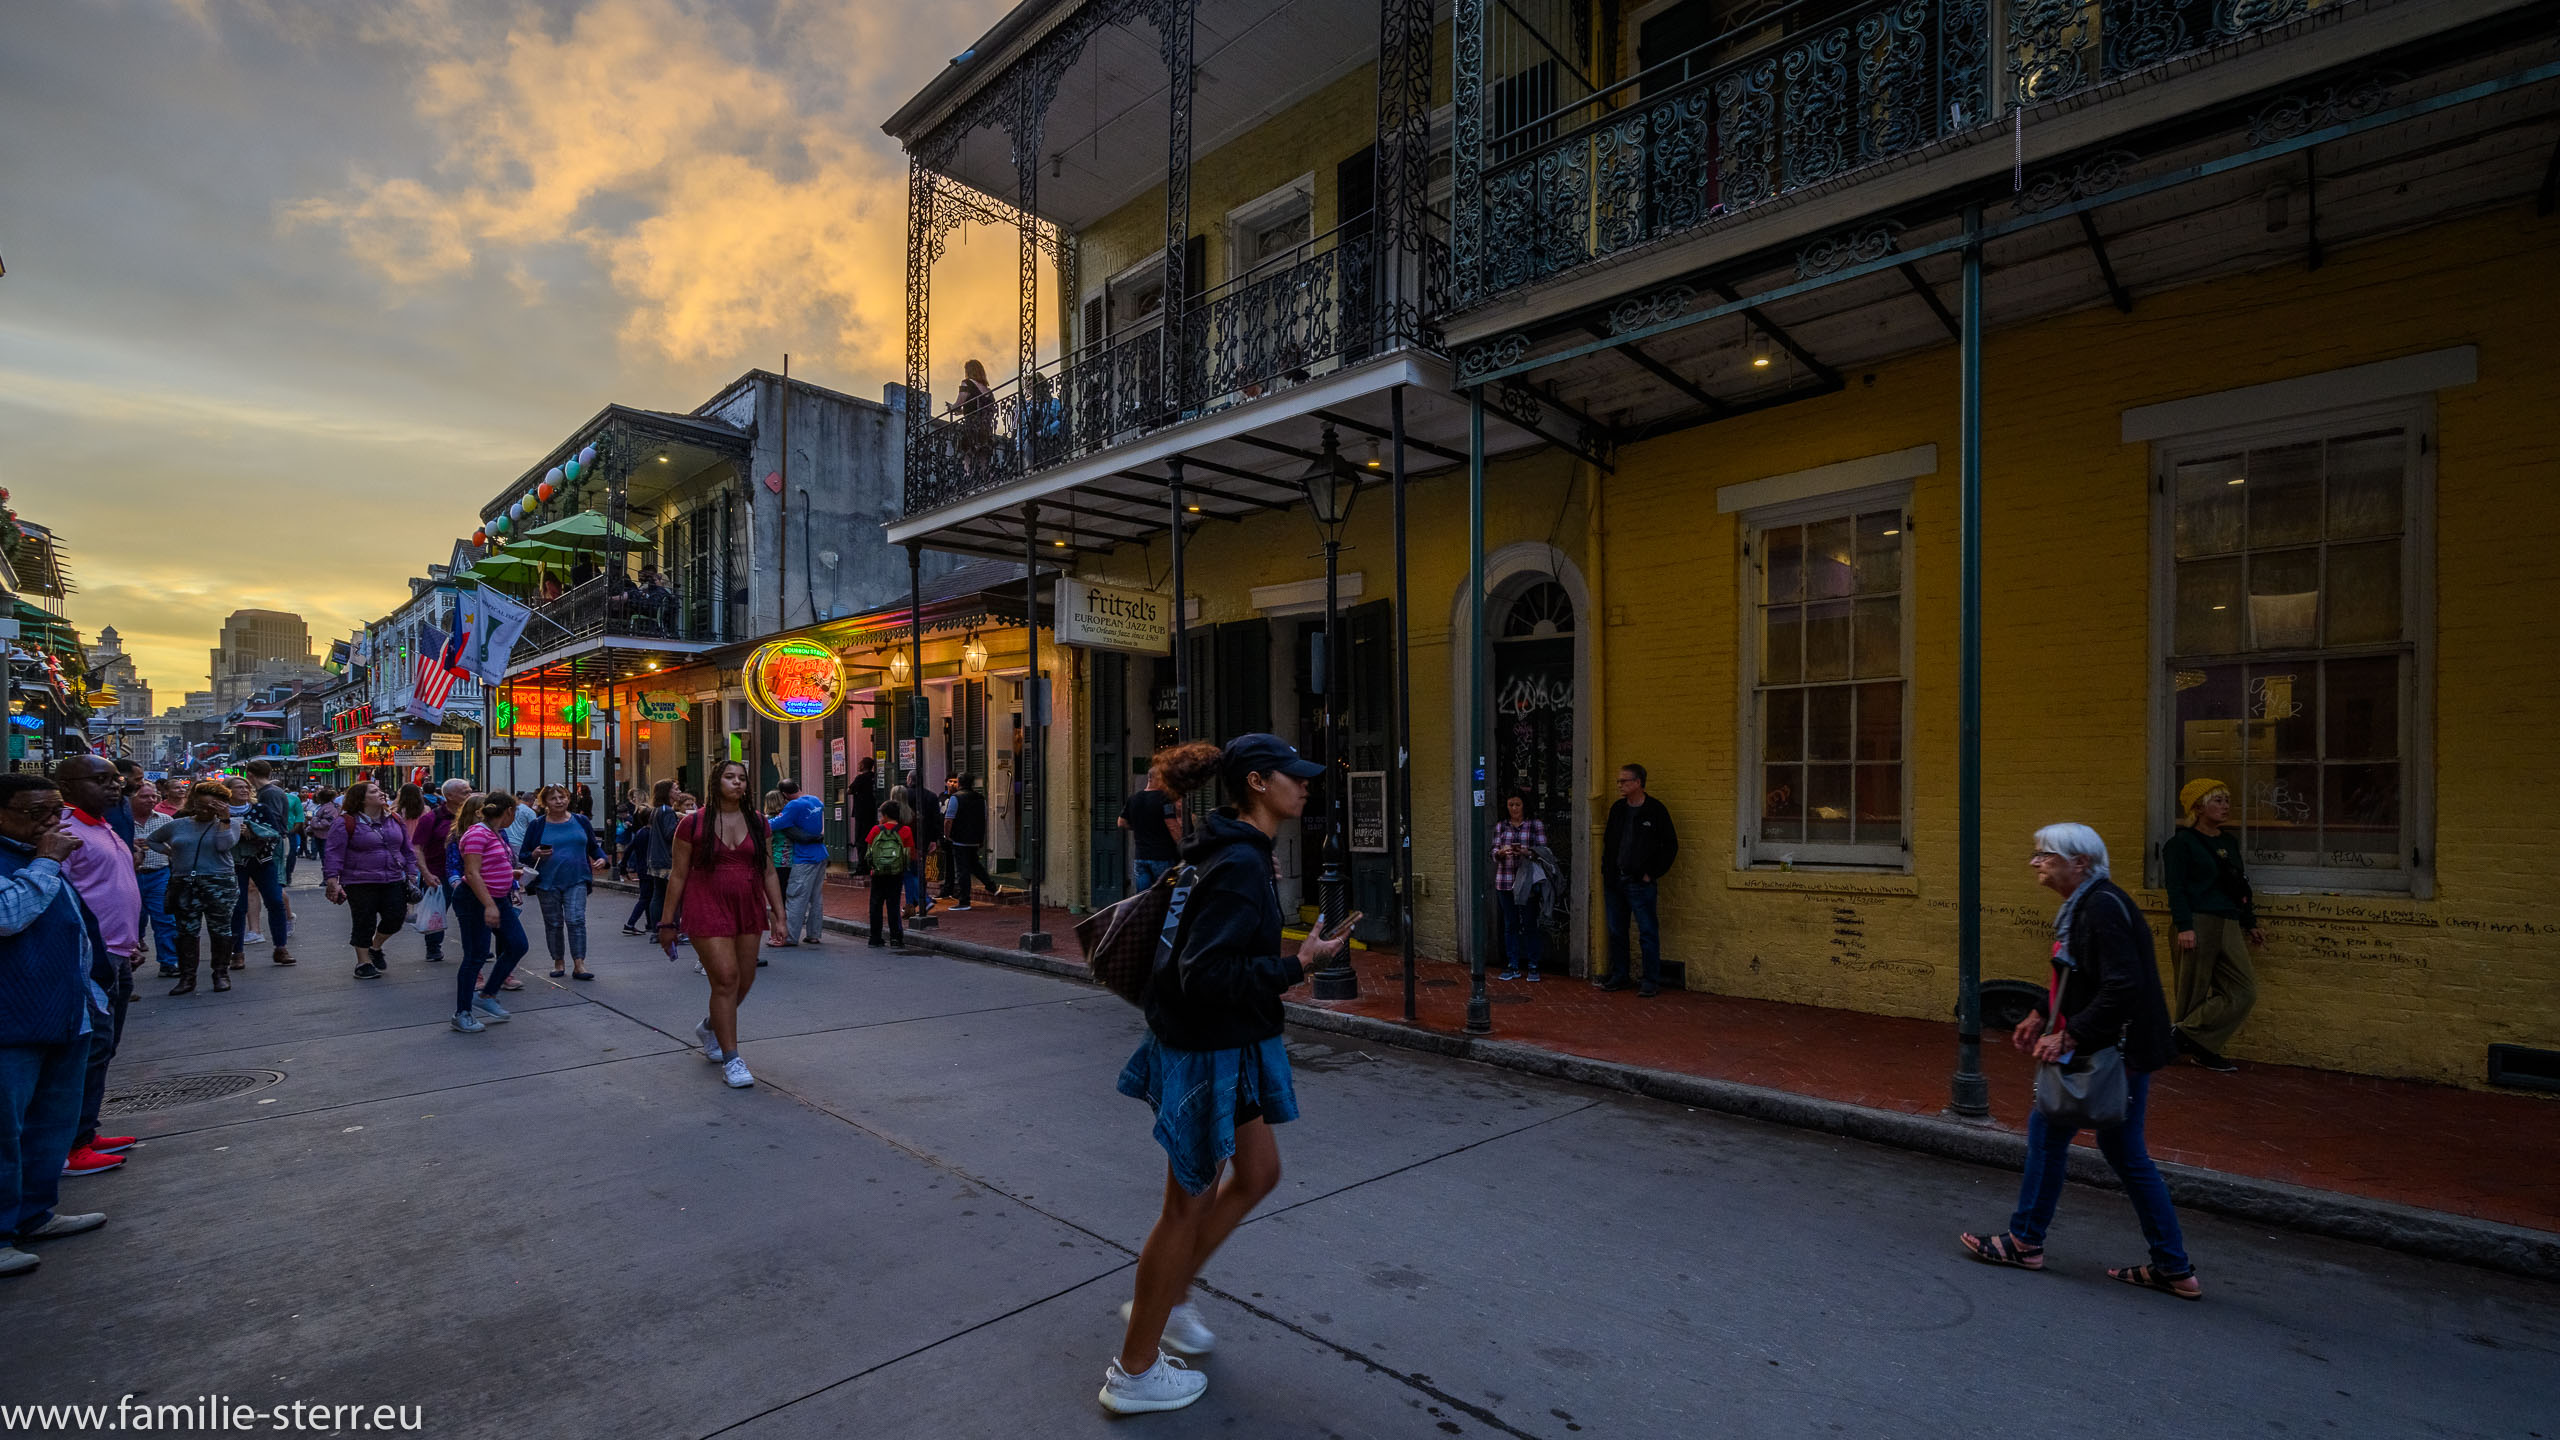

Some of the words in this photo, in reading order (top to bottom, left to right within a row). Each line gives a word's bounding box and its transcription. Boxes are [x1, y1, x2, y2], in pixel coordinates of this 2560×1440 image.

[1074, 613, 1123, 628] EUROPEAN
[1126, 621, 1147, 632] JAZZ
[1149, 625, 1165, 634] PUB
[1081, 624, 1095, 633] New
[1096, 626, 1117, 636] Orleans
[780, 657, 832, 678] Honky
[781, 677, 824, 700] Tonk
[1156, 699, 1178, 711] JAZ
